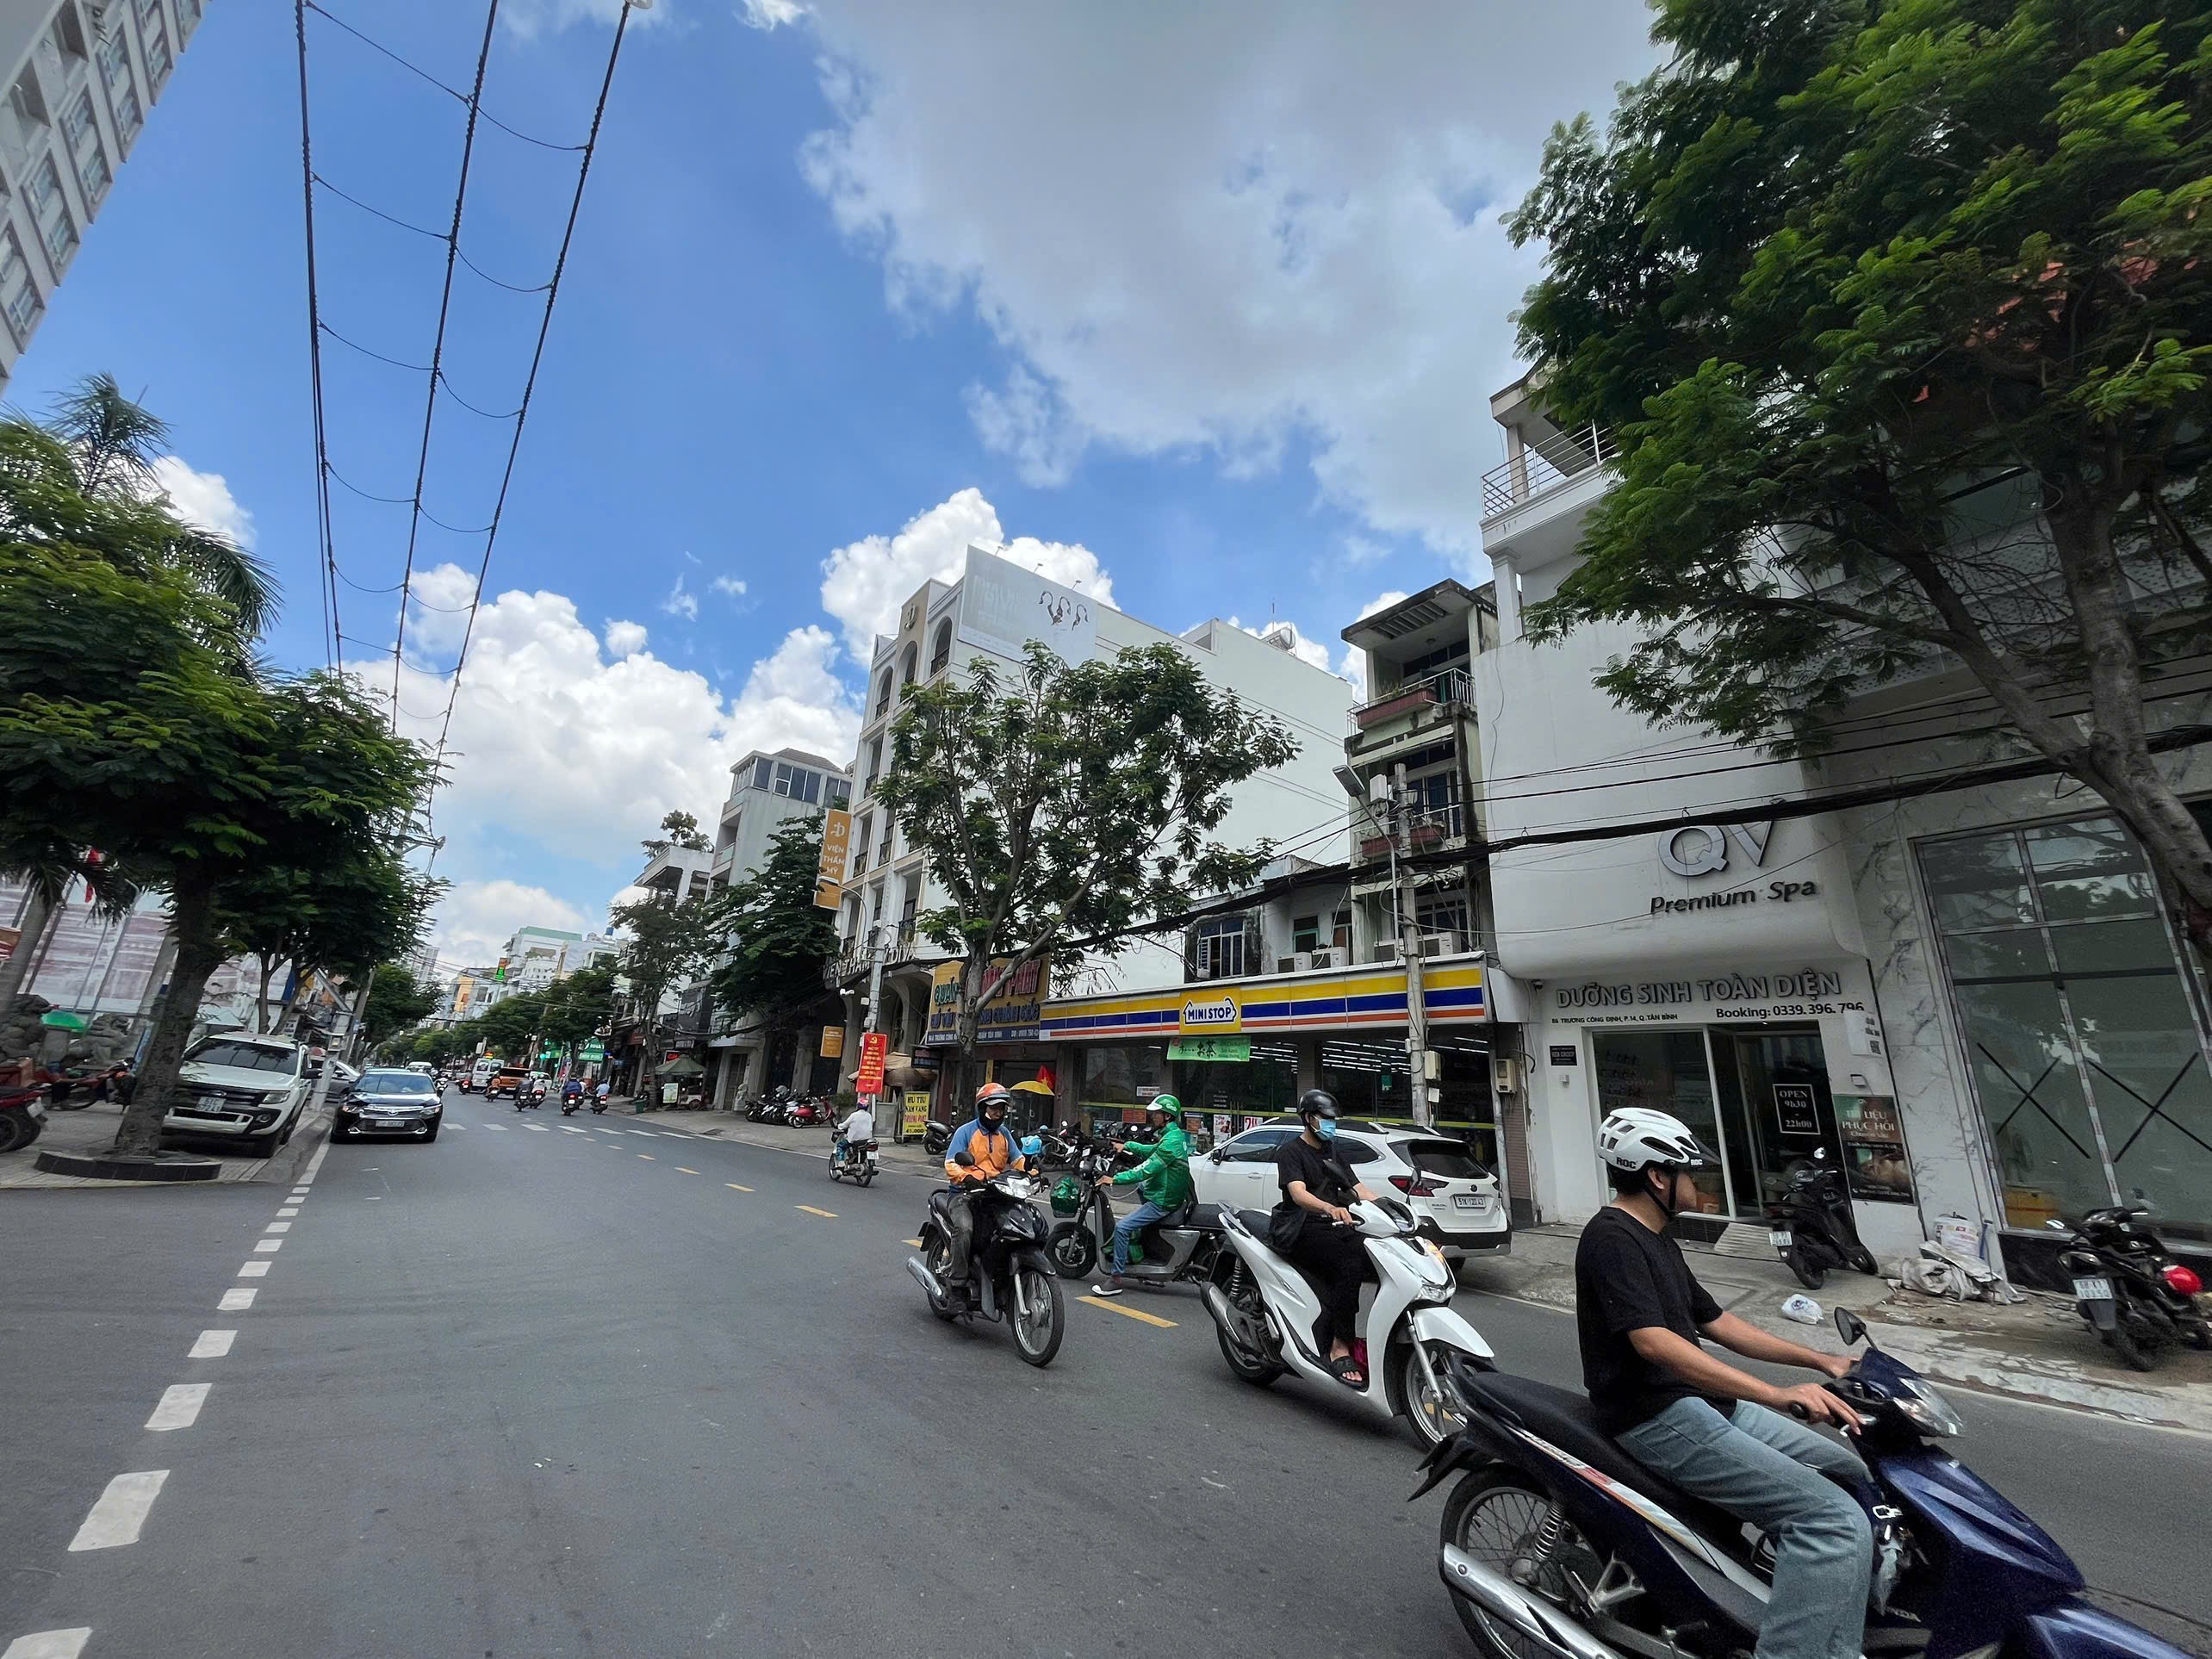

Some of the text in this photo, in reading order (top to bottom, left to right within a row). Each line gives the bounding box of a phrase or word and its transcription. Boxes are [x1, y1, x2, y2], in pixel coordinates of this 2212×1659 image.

[1650, 880, 1817, 914] Premium Spa
[1637, 982, 1692, 1004] SINH
[1698, 972, 1769, 1001] TOÀN
[1774, 967, 1842, 1000] DIỆN
[1716, 1006, 1771, 1020] Booking:
[1786, 1120, 1812, 1128] 22h00
[1616, 1157, 1637, 1169] ROC
